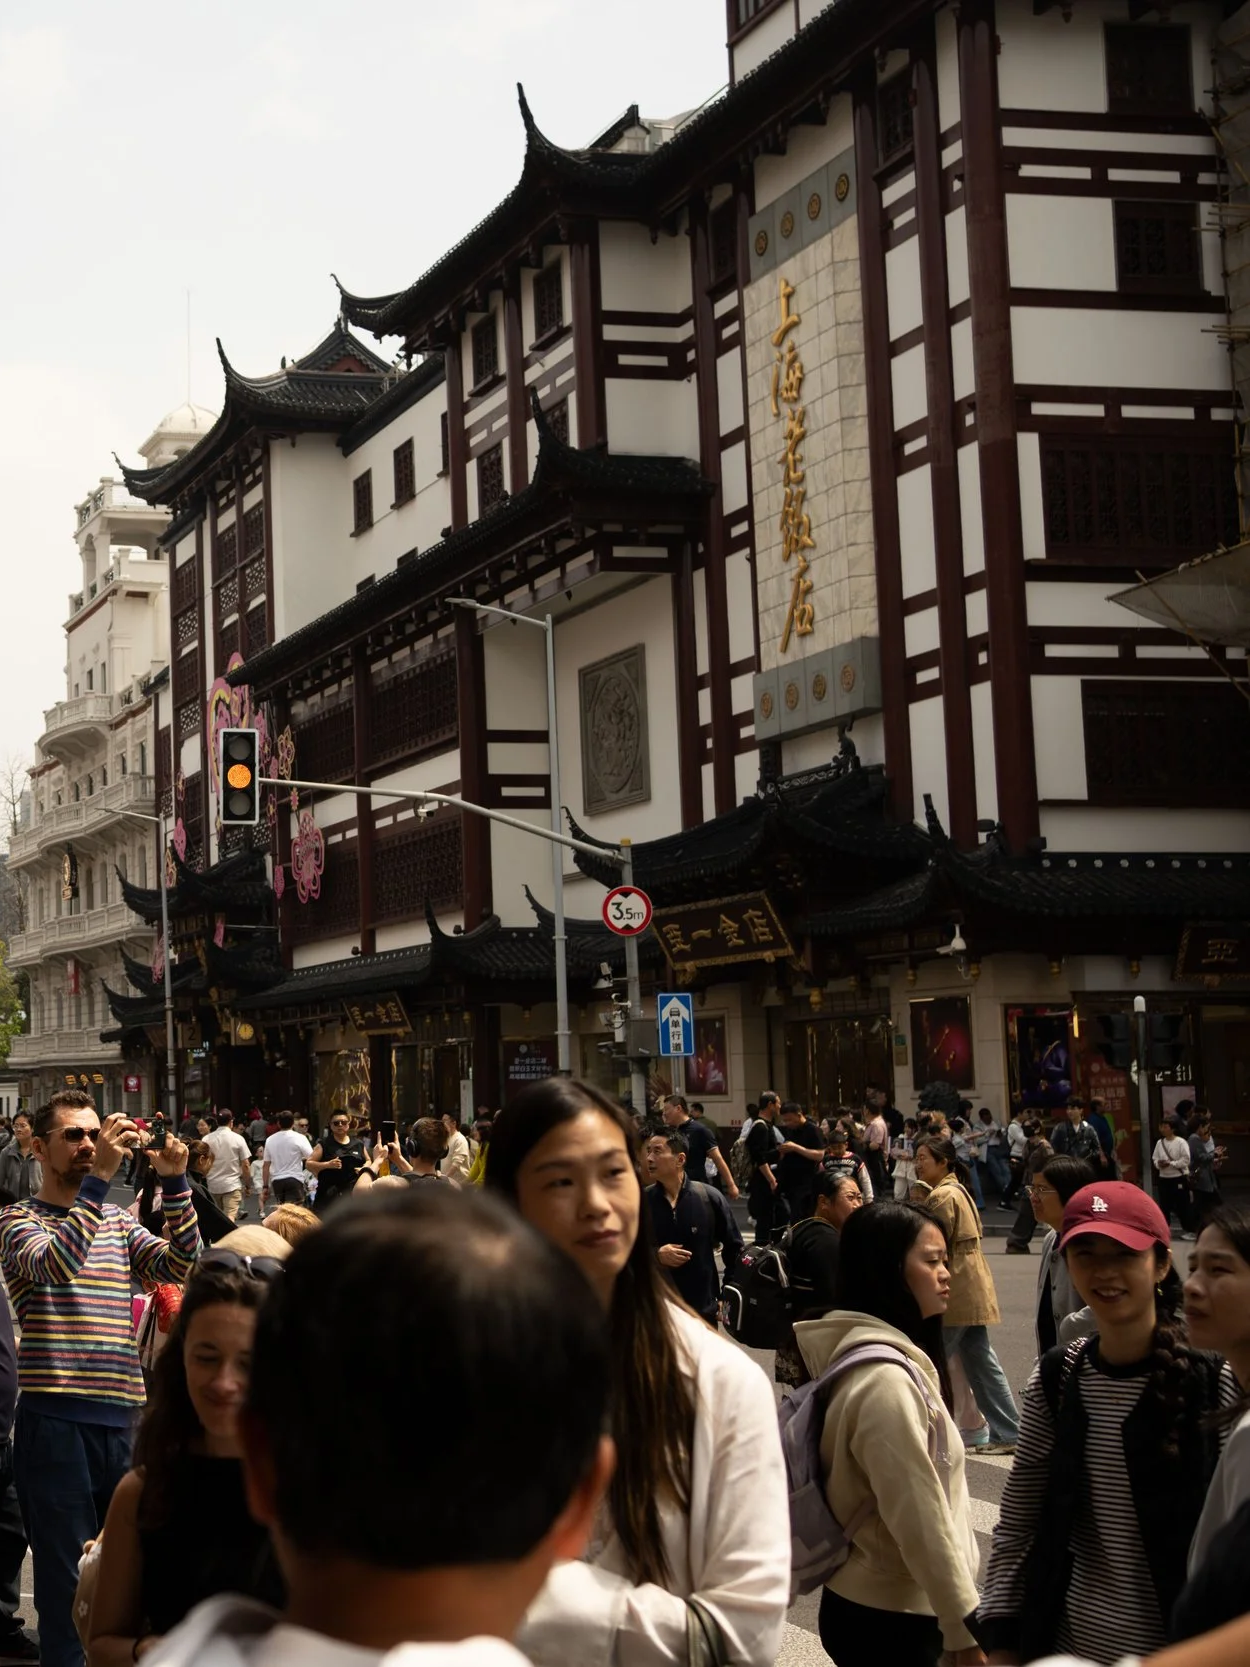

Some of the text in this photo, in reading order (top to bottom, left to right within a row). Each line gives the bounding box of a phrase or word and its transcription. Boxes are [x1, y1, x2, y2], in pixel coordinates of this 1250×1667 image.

[611, 901, 644, 921] 3.5m
[187, 1026, 196, 1041] 2
[670, 1019, 682, 1052] 单行道
[1091, 1196, 1109, 1212] LA
